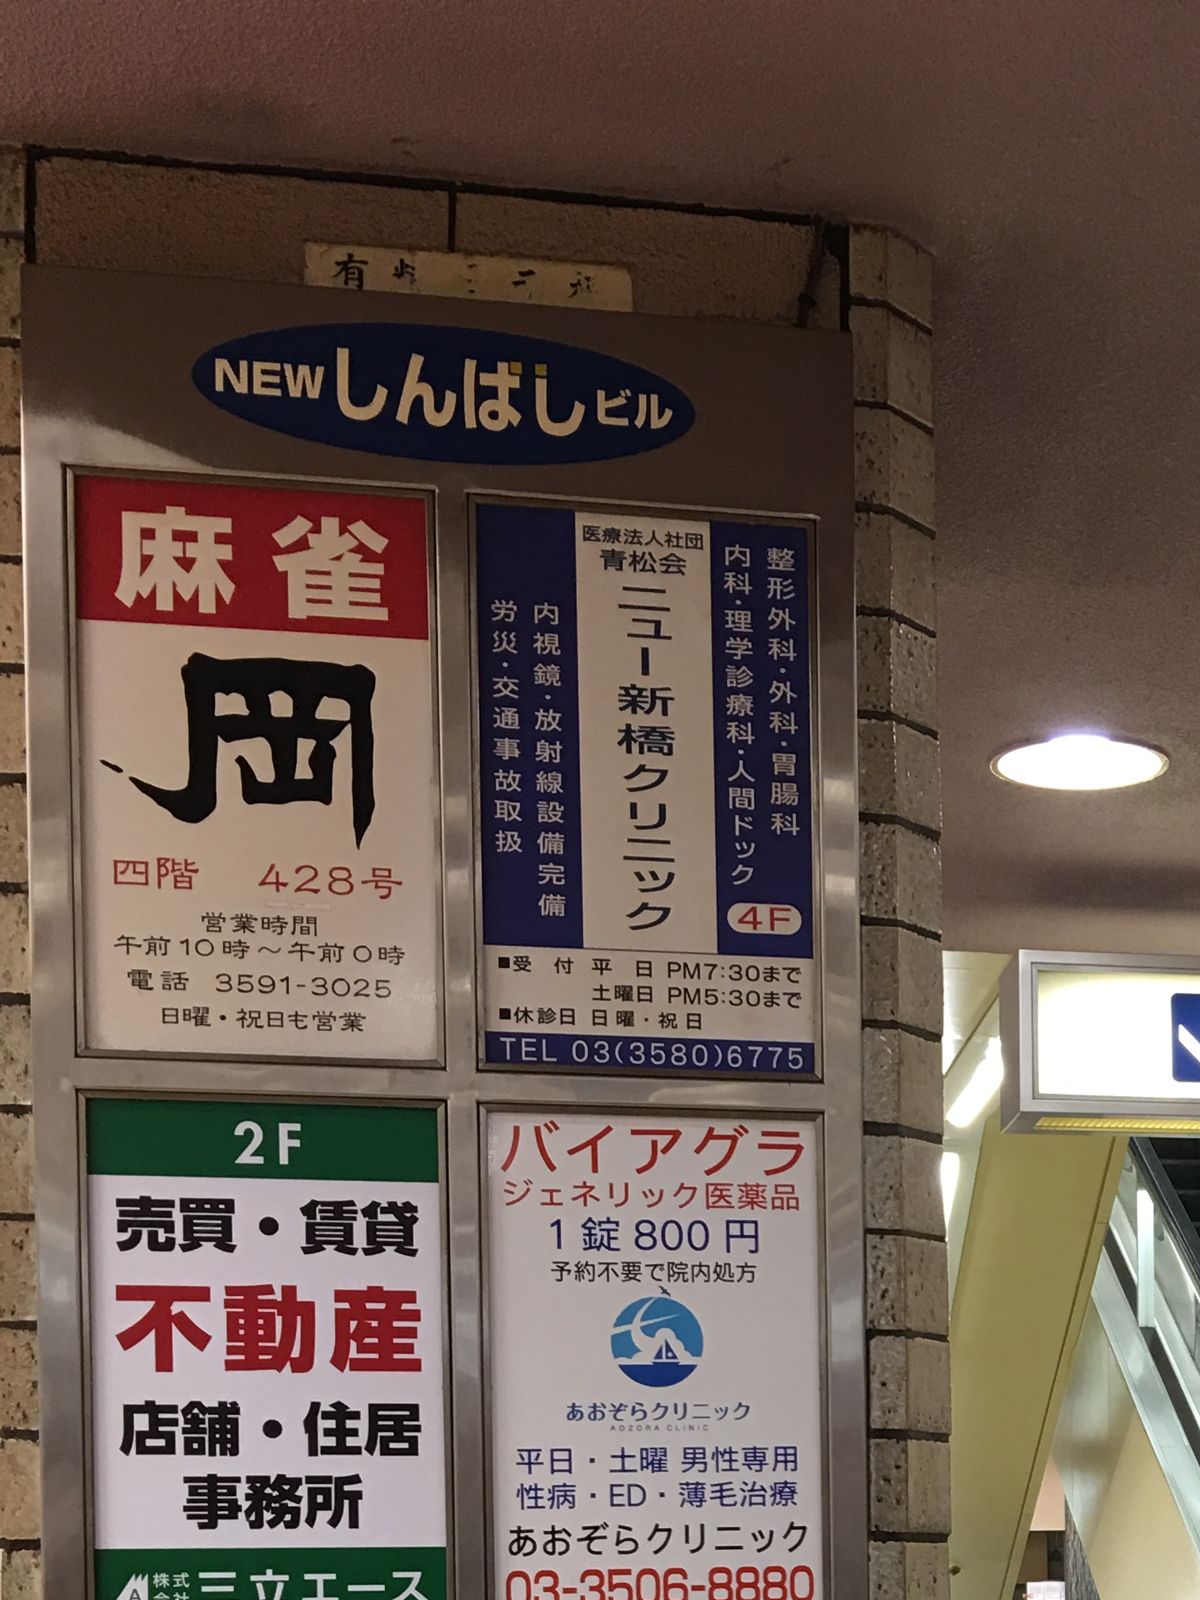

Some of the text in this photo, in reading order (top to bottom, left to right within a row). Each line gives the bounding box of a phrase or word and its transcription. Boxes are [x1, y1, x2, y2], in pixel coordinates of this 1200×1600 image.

[581, 524, 705, 550] 医療法人社団
[114, 505, 390, 622] 麻雀
[599, 548, 688, 576] 青松会
[490, 599, 523, 854] 労災・交通事故取扱
[532, 601, 567, 918] 内視鏡・放射線設備完備
[616, 584, 677, 932] ニュー新橋クリニック
[112, 856, 404, 901] 四階 428号
[200, 911, 319, 938] 営業時間
[736, 905, 793, 932] 4F
[127, 969, 393, 999] 電話 3591-3025
[591, 958, 654, 979] 平日
[666, 962, 803, 985] PM7:30まで
[591, 984, 803, 1010] 土曜日 PM5:30まで
[160, 1006, 368, 1033] 日曜・祝日も営業
[591, 1009, 703, 1031] 日曜・祝日
[499, 1037, 805, 1071] TEL 03(3580)6775
[233, 1119, 302, 1166] 2F
[500, 1119, 805, 1177] バイアグラ
[502, 1178, 801, 1212] ジェネリック医薬品
[115, 1195, 420, 1258] 売買・賃貸
[550, 1260, 758, 1284] 予約不要で院内処方
[115, 1284, 423, 1374] 不動産
[118, 1399, 423, 1457] 店舗・住居
[565, 1401, 752, 1422] あおぞらクリニック
[609, 1424, 710, 1432] AOZORA CLINIC
[515, 1445, 799, 1475] 平日・土曜 男性専用
[182, 1472, 364, 1530] 事務所
[515, 1480, 799, 1512] 性病・ED・薄毛治療
[507, 1521, 809, 1558] あおぞらクリニック
